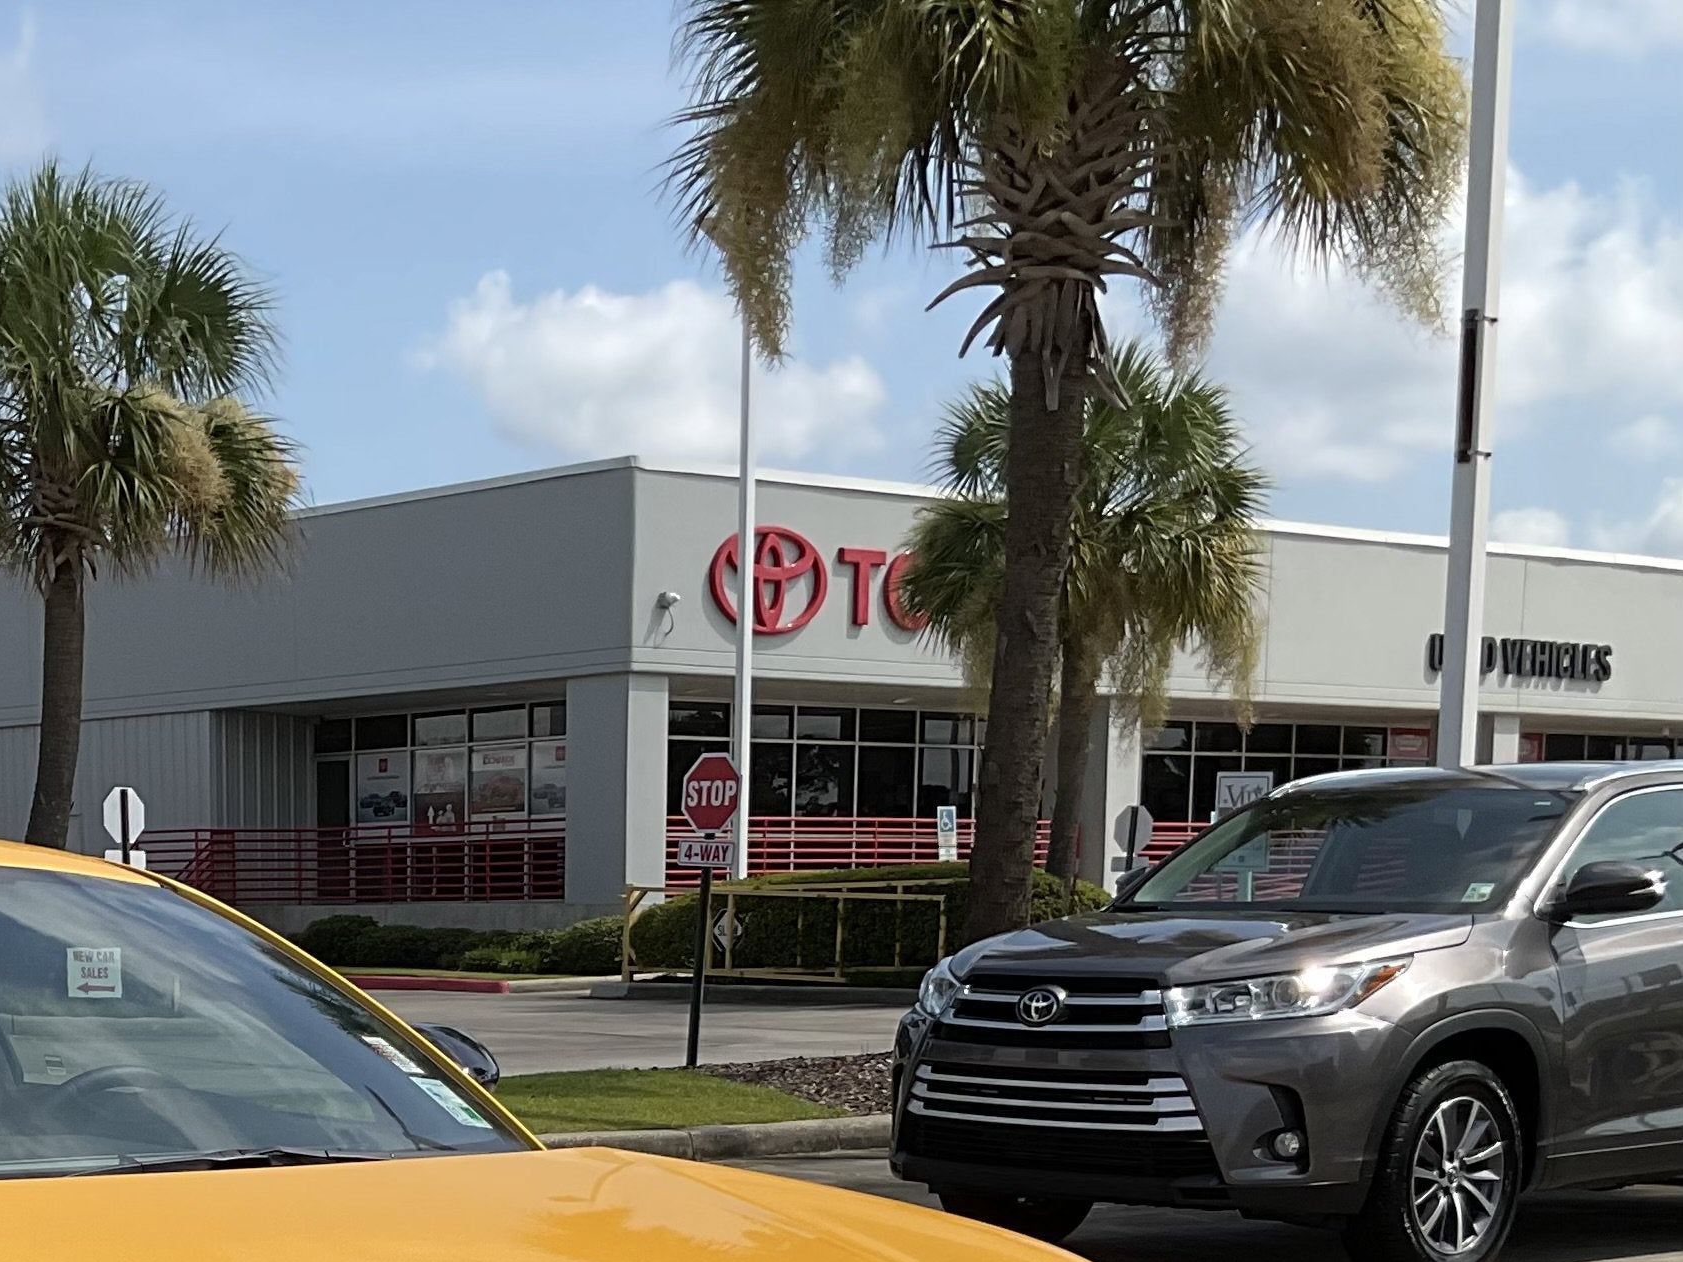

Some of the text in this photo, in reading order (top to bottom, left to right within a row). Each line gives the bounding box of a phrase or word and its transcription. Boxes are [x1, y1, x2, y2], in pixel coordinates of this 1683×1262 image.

[1429, 634, 1612, 681] UD VEHICLES
[687, 780, 737, 807] STOP
[684, 844, 730, 862] 4-WAY
[72, 951, 115, 963] NEW CAR
[81, 966, 109, 978] SALES
